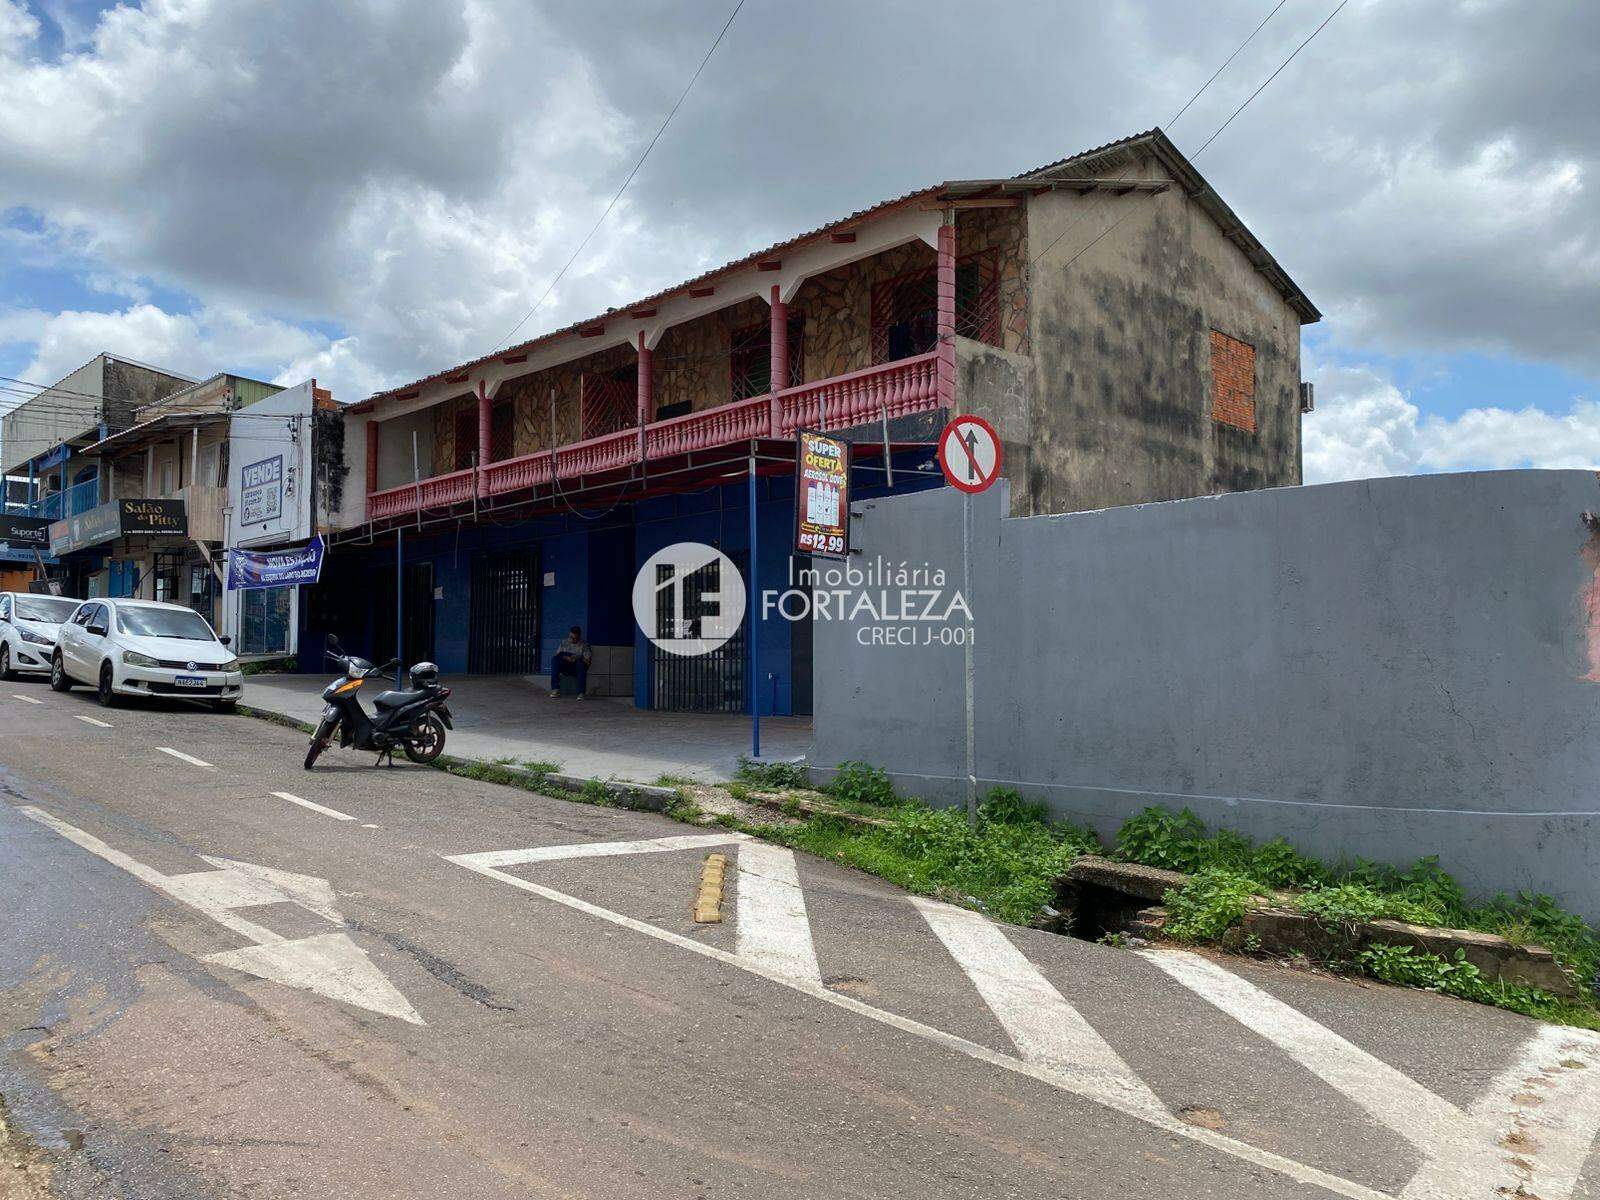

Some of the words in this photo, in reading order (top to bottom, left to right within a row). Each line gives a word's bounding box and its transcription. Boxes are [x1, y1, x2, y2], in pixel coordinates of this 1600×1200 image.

[808, 440, 842, 458] SUPER
[805, 454, 843, 472] OFERTA
[243, 460, 280, 488] VENDE
[11, 527, 42, 537] Suporte
